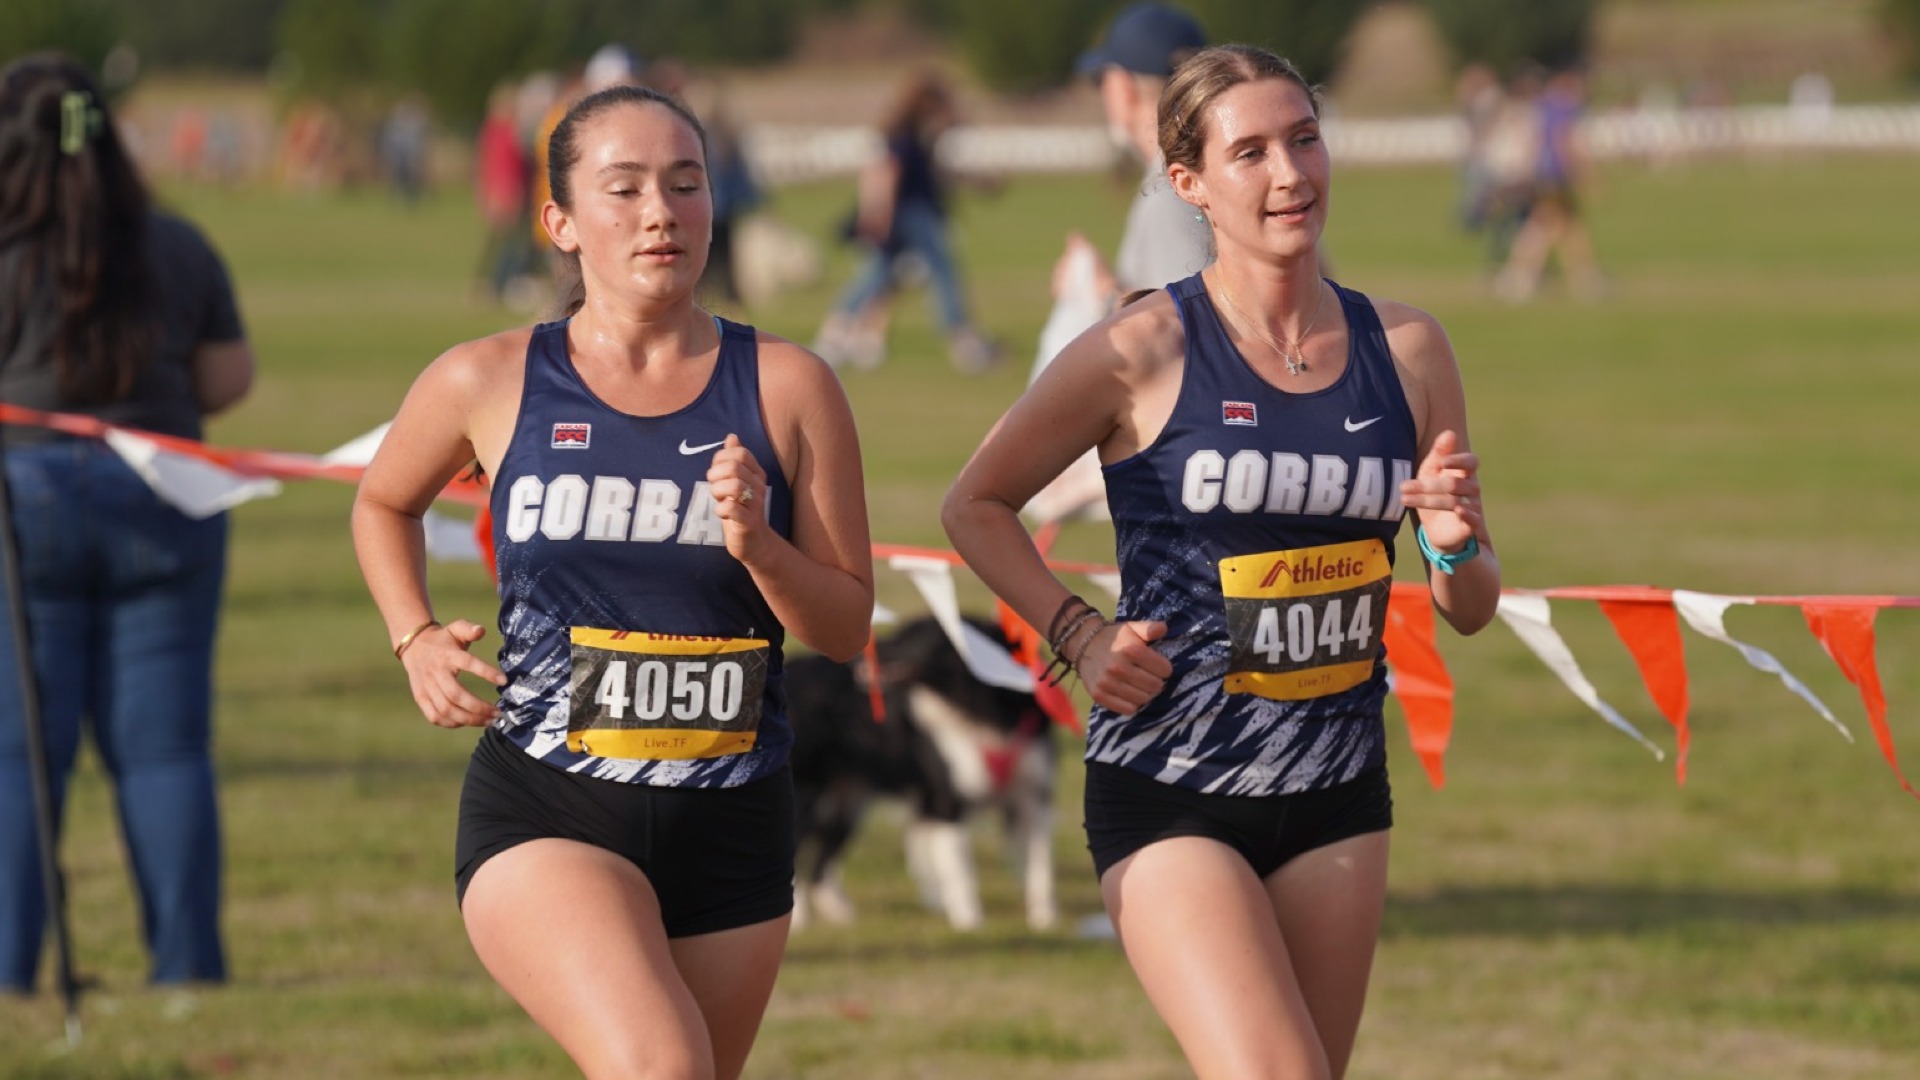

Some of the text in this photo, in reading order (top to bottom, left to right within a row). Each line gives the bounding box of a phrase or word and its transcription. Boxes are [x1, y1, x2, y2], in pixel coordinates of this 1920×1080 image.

[506, 474, 771, 546] CORBA
[1253, 595, 1373, 664] 4044
[595, 661, 743, 721] 4050
[644, 737, 687, 748] Live.TF
